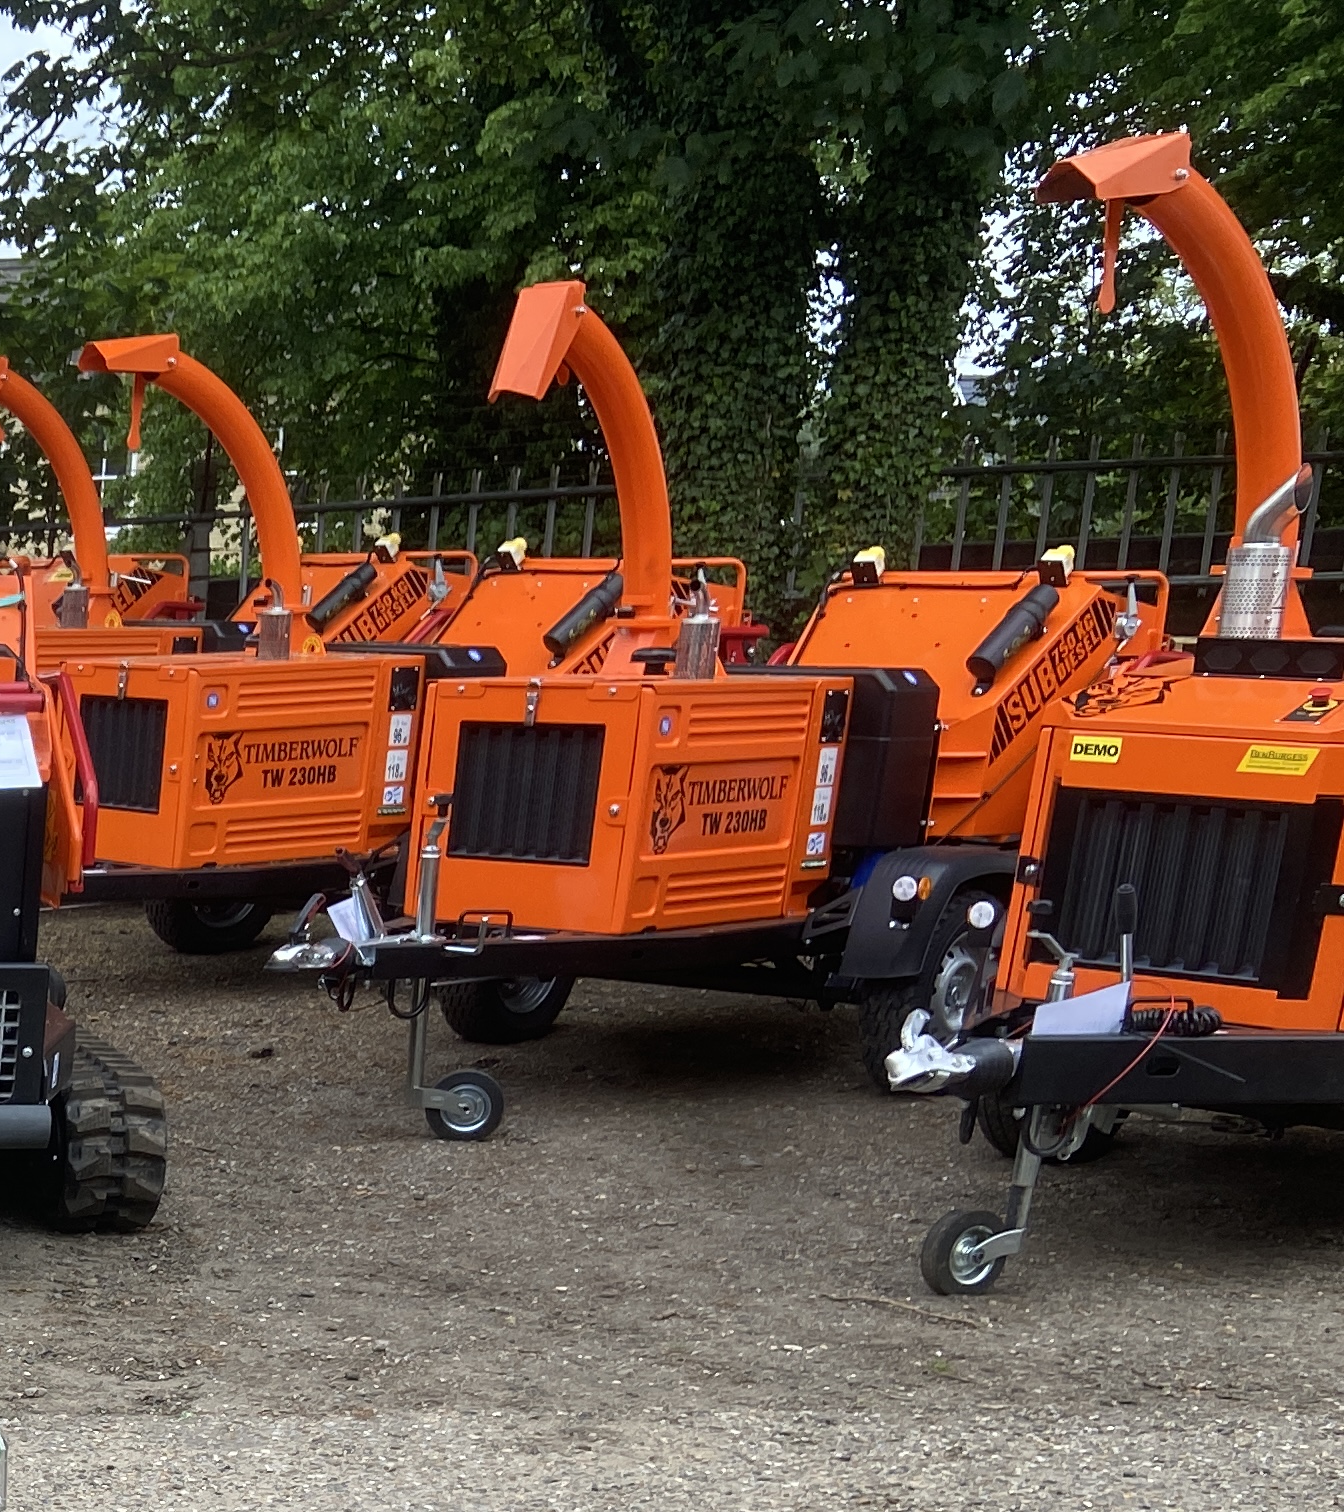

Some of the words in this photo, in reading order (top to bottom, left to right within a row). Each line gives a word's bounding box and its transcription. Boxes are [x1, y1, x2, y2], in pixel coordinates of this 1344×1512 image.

[1051, 631, 1078, 667] 750
[1075, 611, 1096, 641] KG
[1056, 630, 1102, 684] DIESEL
[1006, 659, 1057, 730] SUB
[243, 736, 360, 765] TIMBERWOLF
[1073, 743, 1119, 757] DEMO
[261, 767, 286, 789] TW
[287, 764, 337, 787] 230HB
[687, 775, 789, 806] TIMBERWOLF
[701, 812, 723, 837] TW
[724, 808, 768, 835] 230HB
